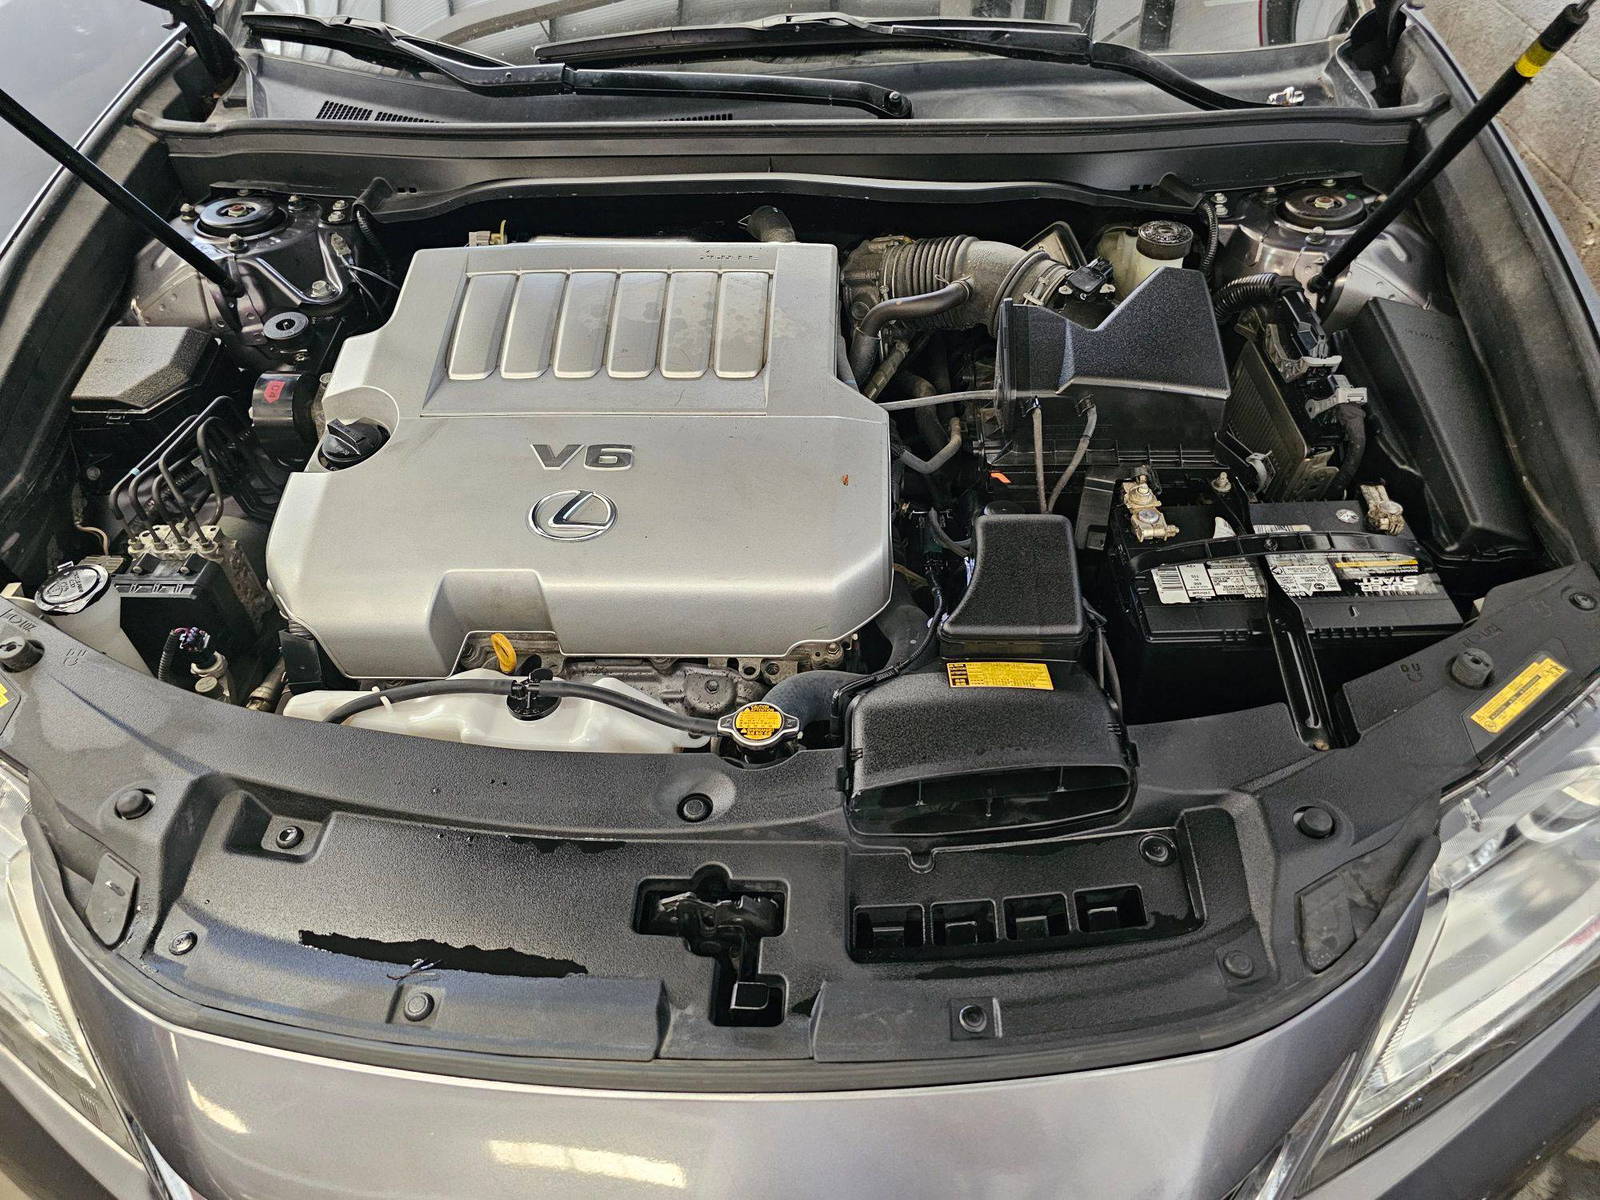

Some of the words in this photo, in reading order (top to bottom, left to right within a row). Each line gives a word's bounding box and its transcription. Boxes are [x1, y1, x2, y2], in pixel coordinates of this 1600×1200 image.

[530, 444, 633, 471] V6
[1359, 576, 1418, 585] START
[1360, 584, 1416, 592] SUPER
